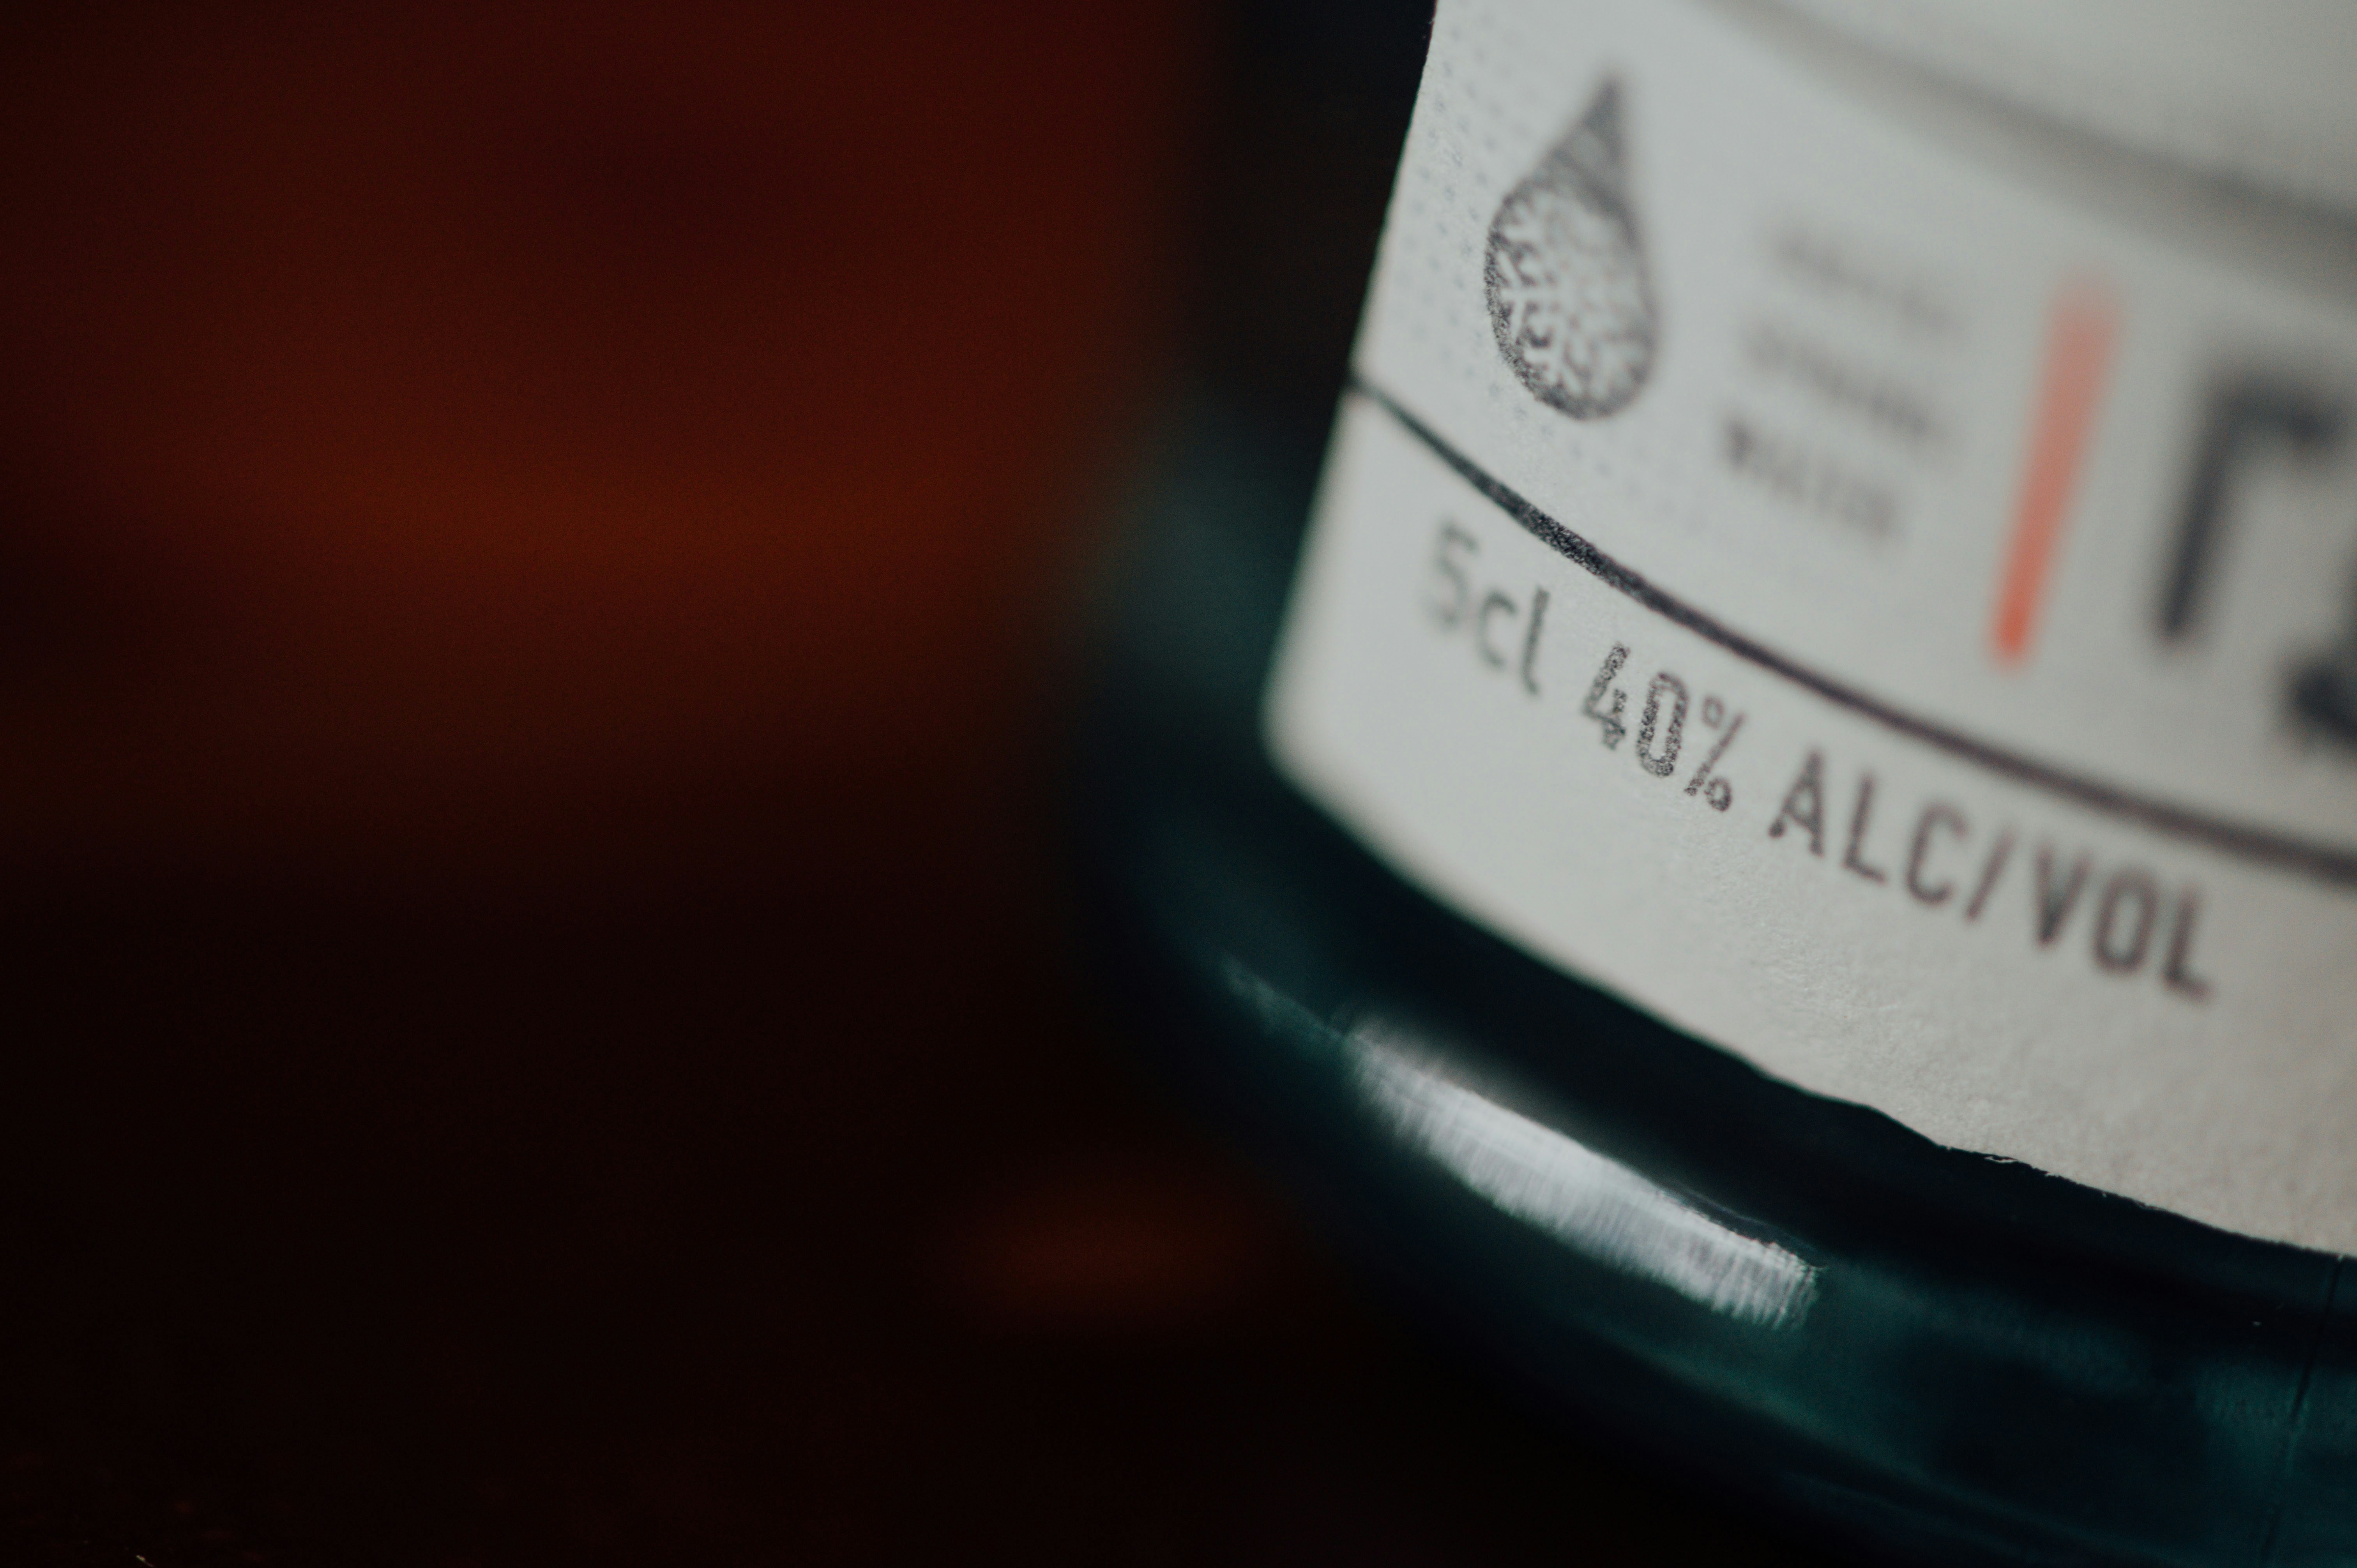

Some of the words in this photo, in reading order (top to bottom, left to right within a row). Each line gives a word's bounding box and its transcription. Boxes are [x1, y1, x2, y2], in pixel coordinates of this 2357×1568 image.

[1424, 516, 1550, 697] 5cl
[1581, 641, 1746, 812] 40%
[1767, 746, 2216, 1005] ALC/VOL
